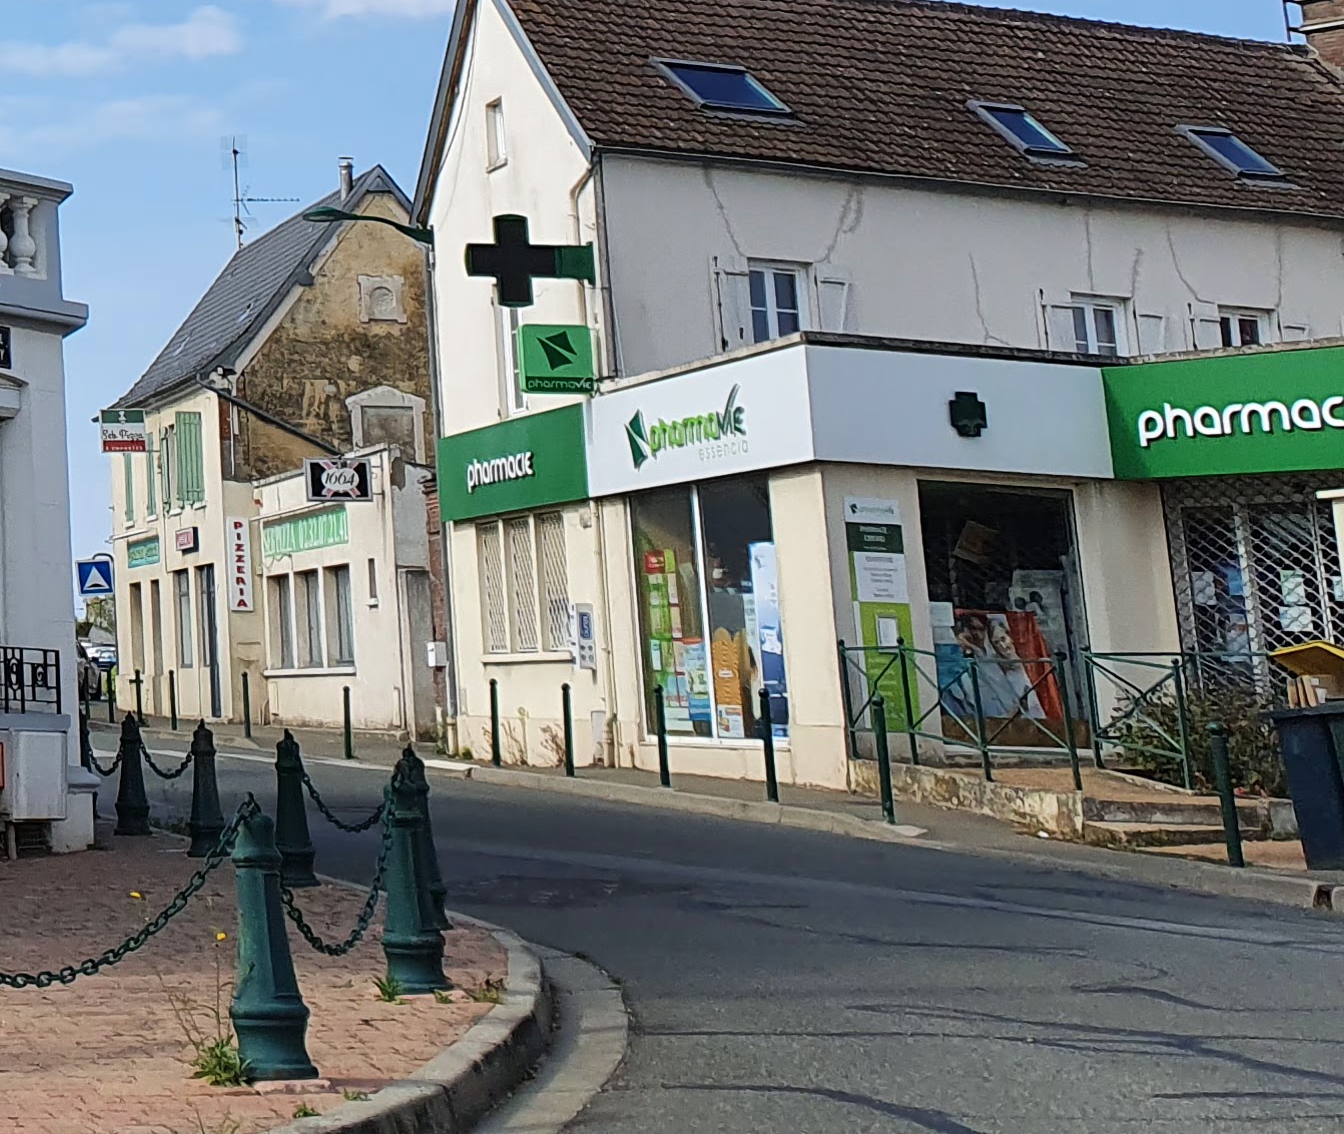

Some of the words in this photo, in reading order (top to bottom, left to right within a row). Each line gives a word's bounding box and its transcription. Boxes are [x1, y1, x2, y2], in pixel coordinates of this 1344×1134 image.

[1138, 395, 1344, 447] pharmac
[324, 471, 355, 486] 1664
[233, 521, 248, 608] PIZZERIA
